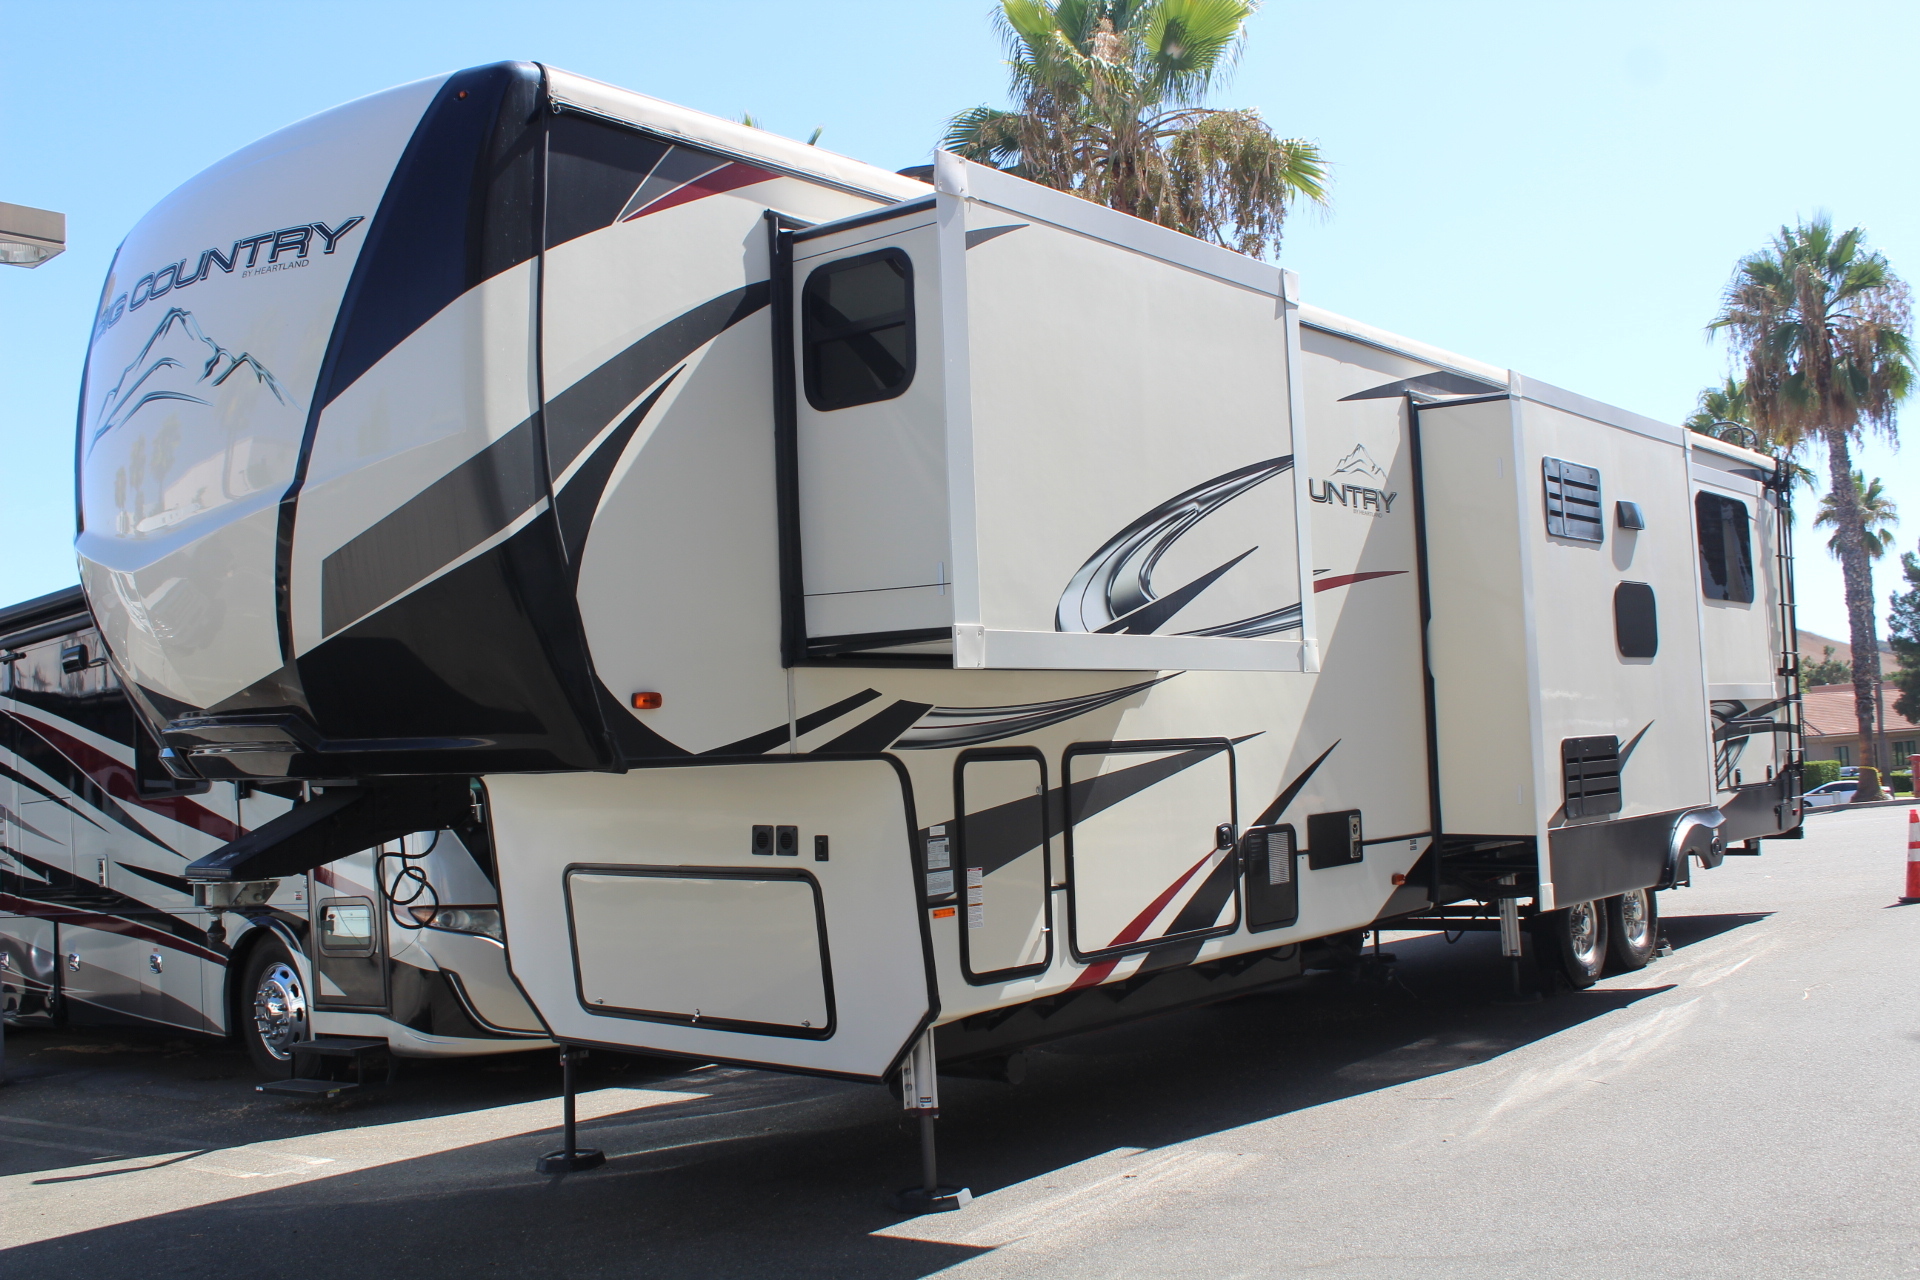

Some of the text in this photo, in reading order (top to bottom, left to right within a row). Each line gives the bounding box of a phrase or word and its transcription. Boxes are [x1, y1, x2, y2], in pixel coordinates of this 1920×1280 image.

[129, 215, 366, 312] COUNTRY
[242, 259, 310, 278] BY HEARTLAND
